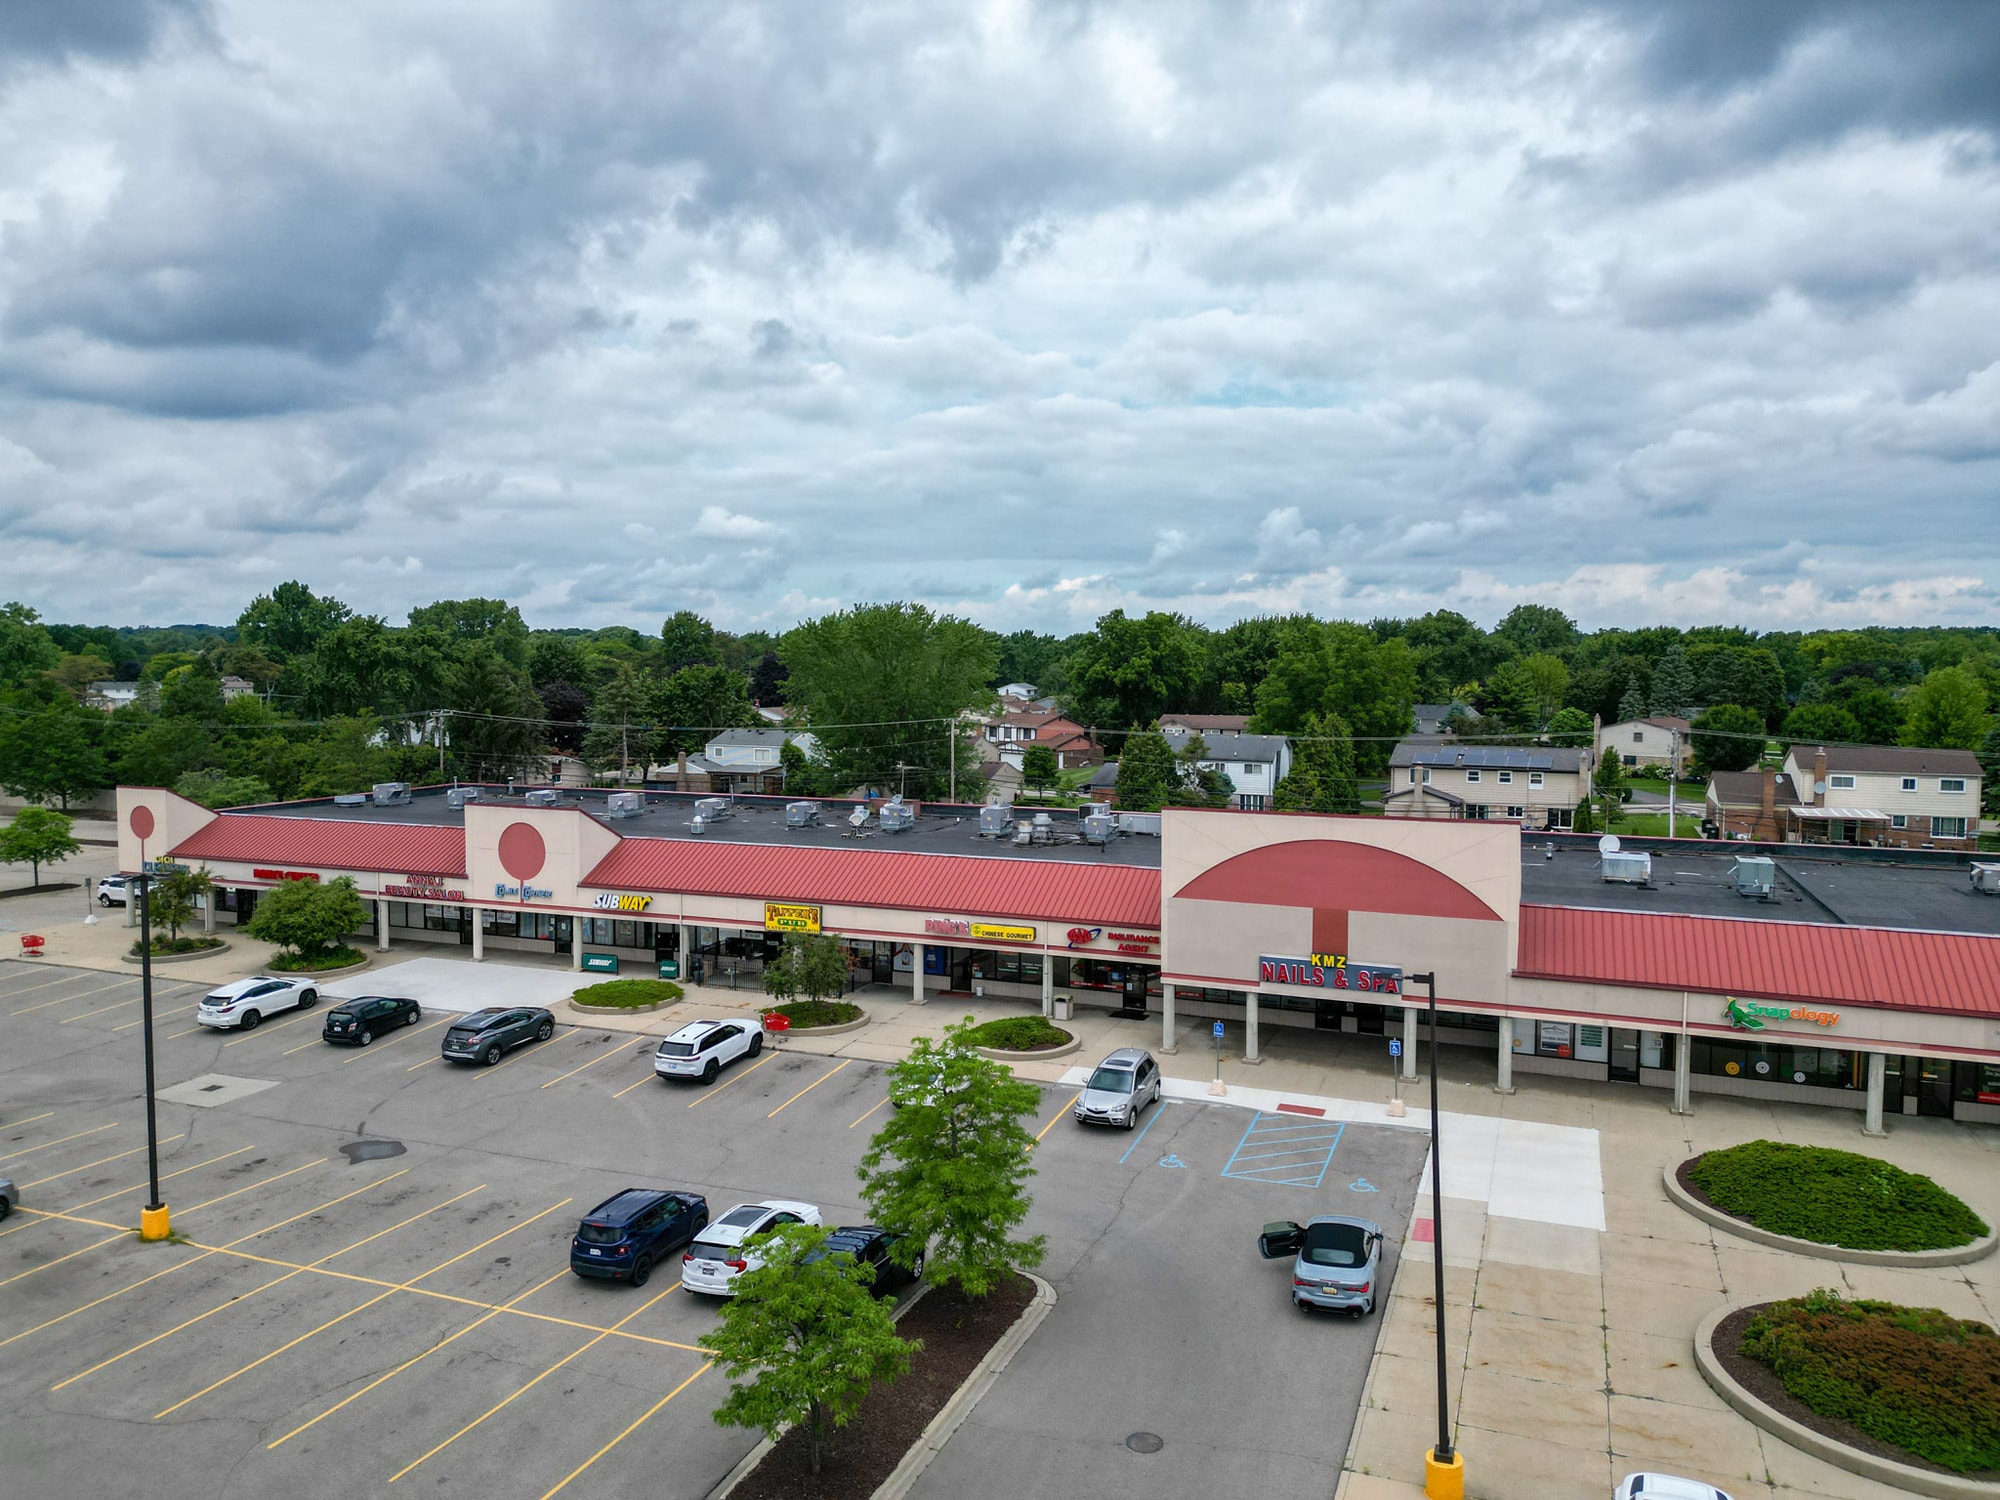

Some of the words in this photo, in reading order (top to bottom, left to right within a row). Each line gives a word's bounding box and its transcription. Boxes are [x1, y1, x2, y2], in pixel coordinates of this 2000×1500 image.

[385, 884, 426, 897] BEAUTY
[428, 888, 464, 901] SALON
[593, 894, 653, 912] SUBWAY
[767, 905, 818, 925] TAPPER'S
[780, 919, 806, 927] PUB
[925, 918, 969, 936] PING'S
[981, 930, 1003, 938] CHINESE
[1006, 932, 1032, 940] GOURMET
[1067, 928, 1092, 944] AAA
[1107, 932, 1161, 945] INSURANCE
[1118, 943, 1149, 953] AGENT
[1311, 954, 1347, 968] KMZ
[1261, 961, 1325, 987] NAILS
[1334, 969, 1349, 989] &
[1357, 970, 1400, 994] SPA
[1746, 1001, 1841, 1027] Snapology
